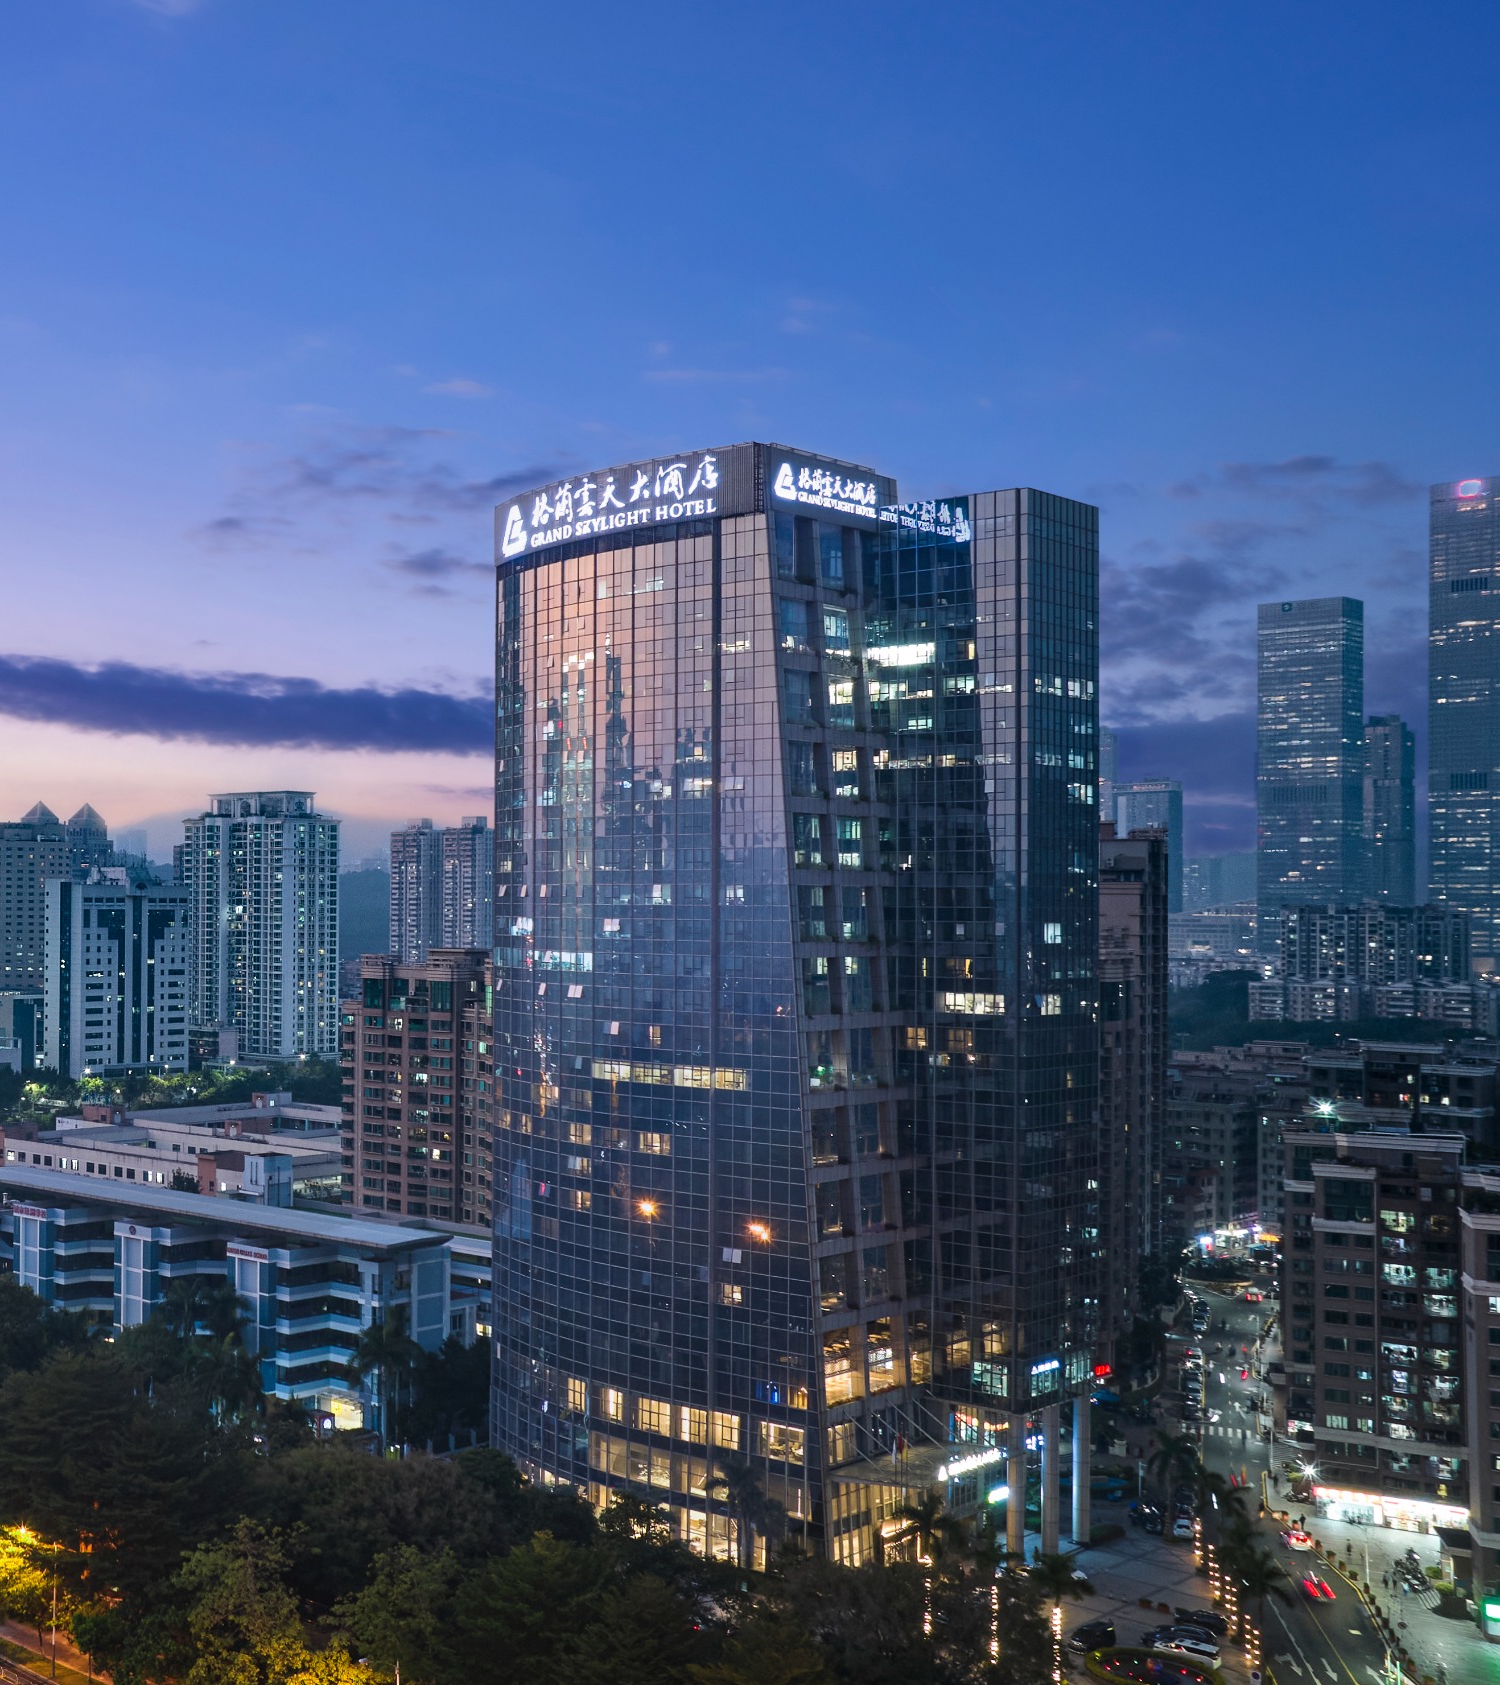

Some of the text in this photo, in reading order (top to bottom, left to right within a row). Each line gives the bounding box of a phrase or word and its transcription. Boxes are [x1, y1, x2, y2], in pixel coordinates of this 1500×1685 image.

[530, 498, 717, 548] GRAND SKYLIGHT HOTEL
[798, 492, 822, 508] GRAND
[822, 497, 855, 514] SKYLIGHT
[855, 503, 877, 519] HOTEL
